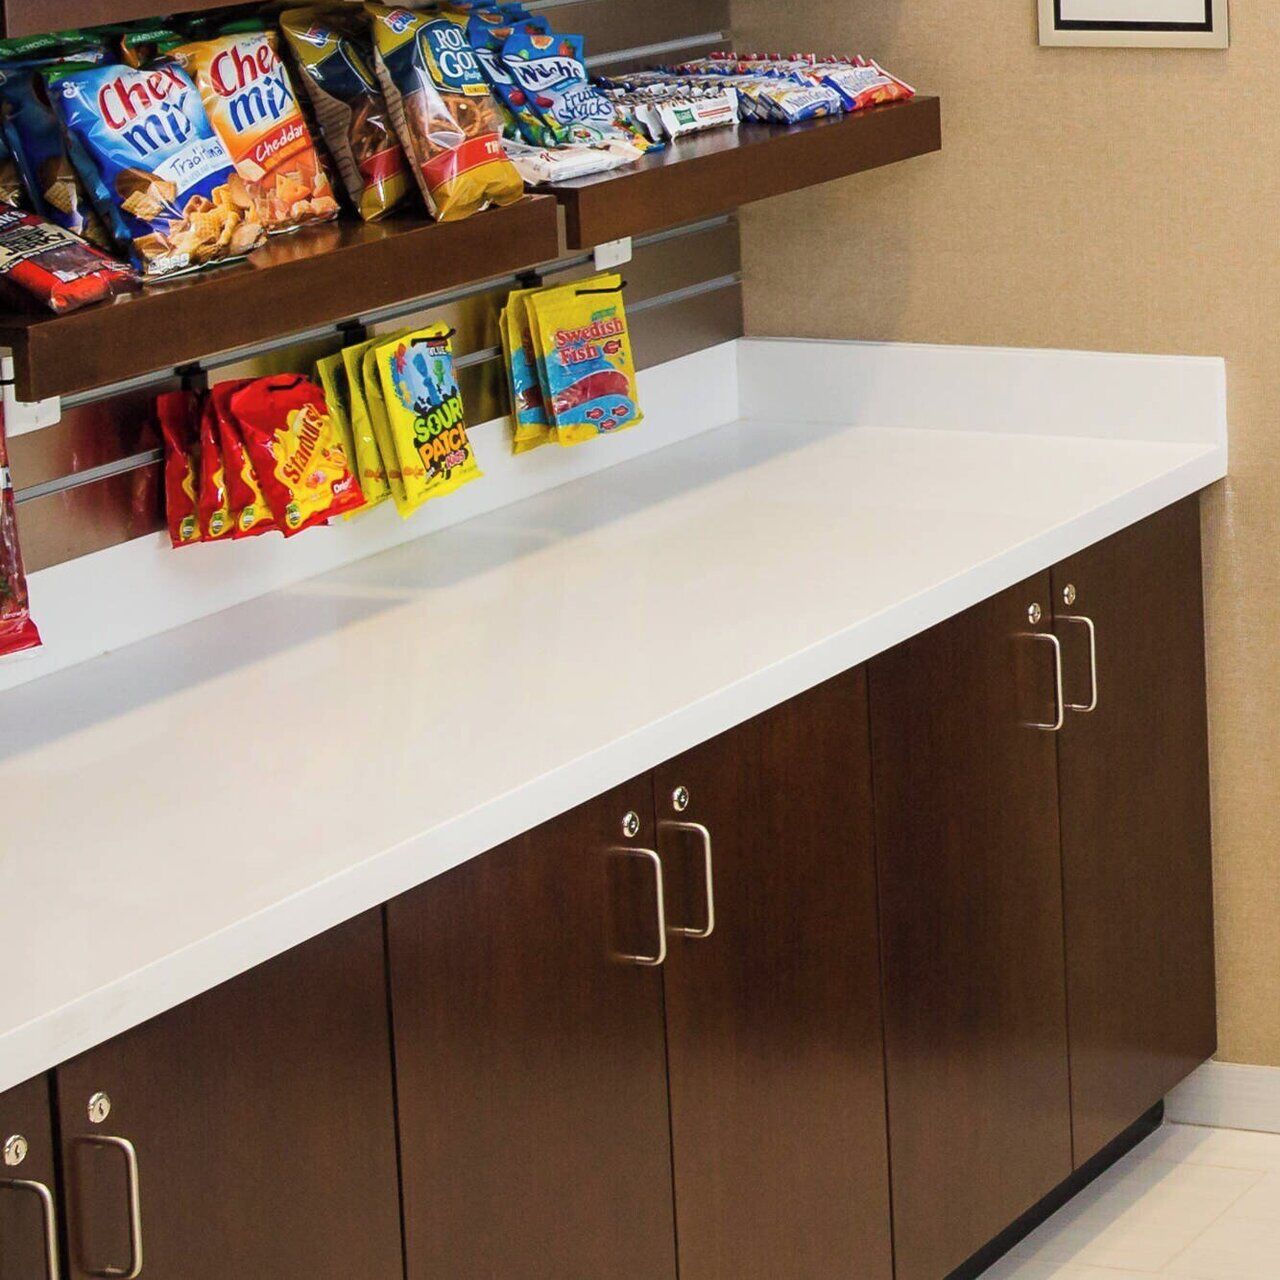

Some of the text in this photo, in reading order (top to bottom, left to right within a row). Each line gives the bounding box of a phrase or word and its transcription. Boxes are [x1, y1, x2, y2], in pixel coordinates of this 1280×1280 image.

[519, 60, 581, 85] Welch's
[99, 68, 188, 133] Chex
[229, 75, 295, 132] mix
[256, 124, 305, 163] Cheddar
[556, 317, 625, 347] Swedish
[560, 344, 599, 367] Fish
[414, 396, 463, 443] SOUR
